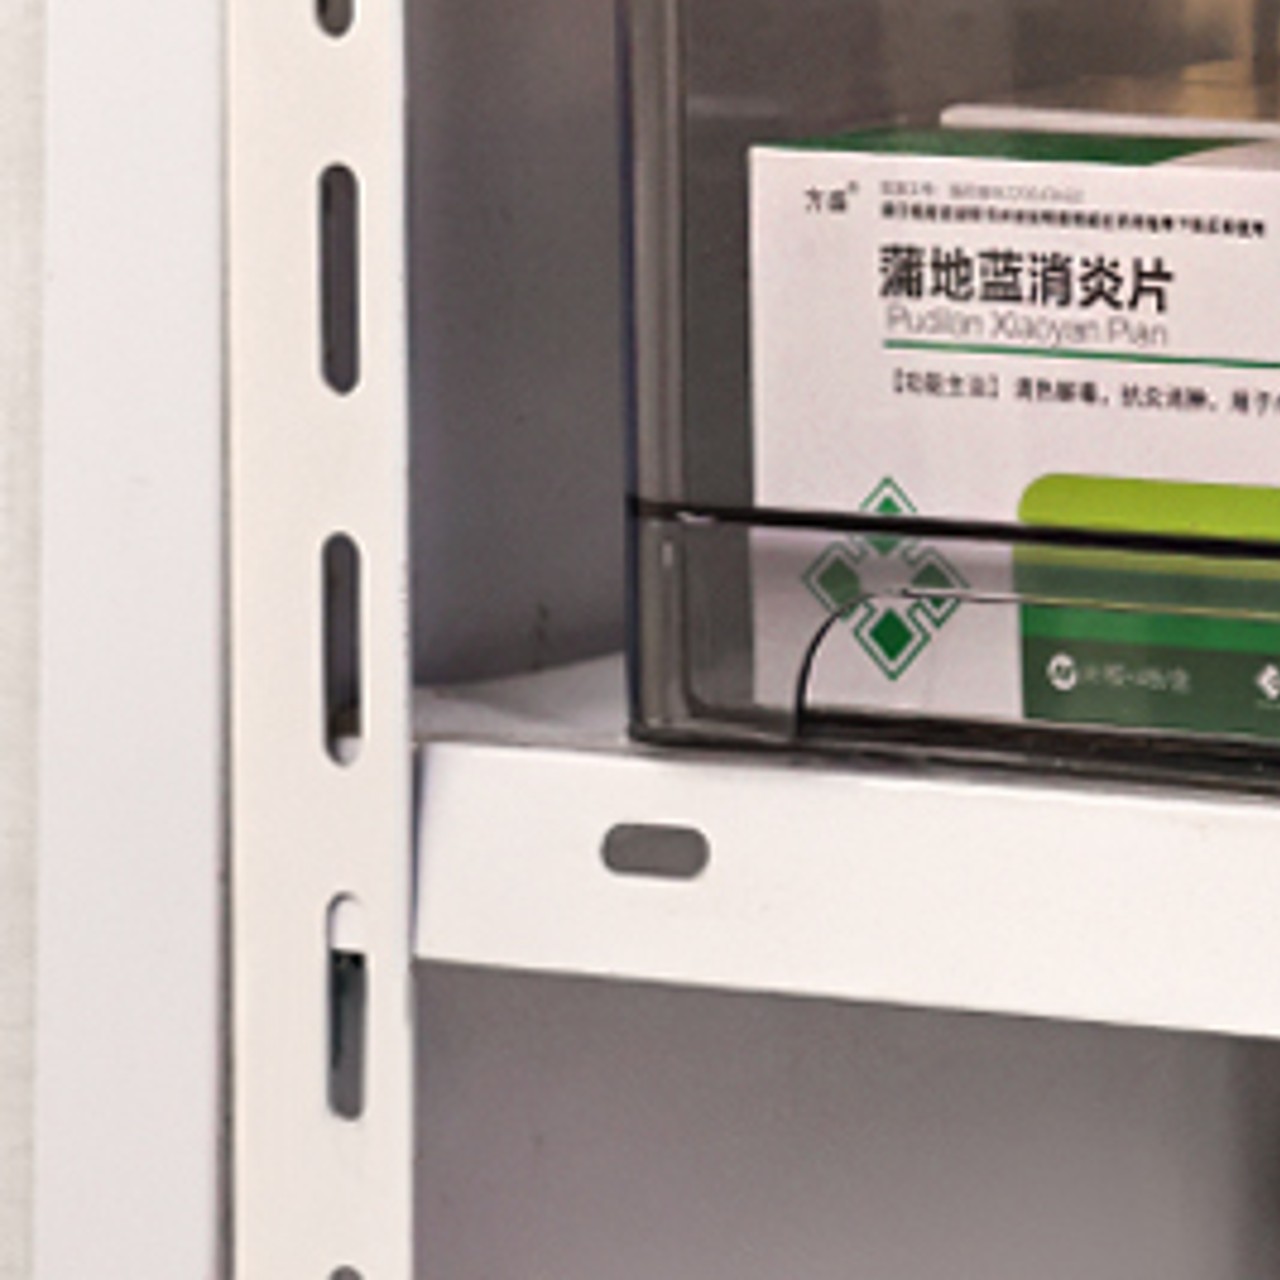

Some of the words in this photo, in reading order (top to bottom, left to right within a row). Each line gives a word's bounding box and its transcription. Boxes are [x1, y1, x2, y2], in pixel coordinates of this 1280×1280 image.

[879, 243, 1174, 313] 蒲地蓝消炎片
